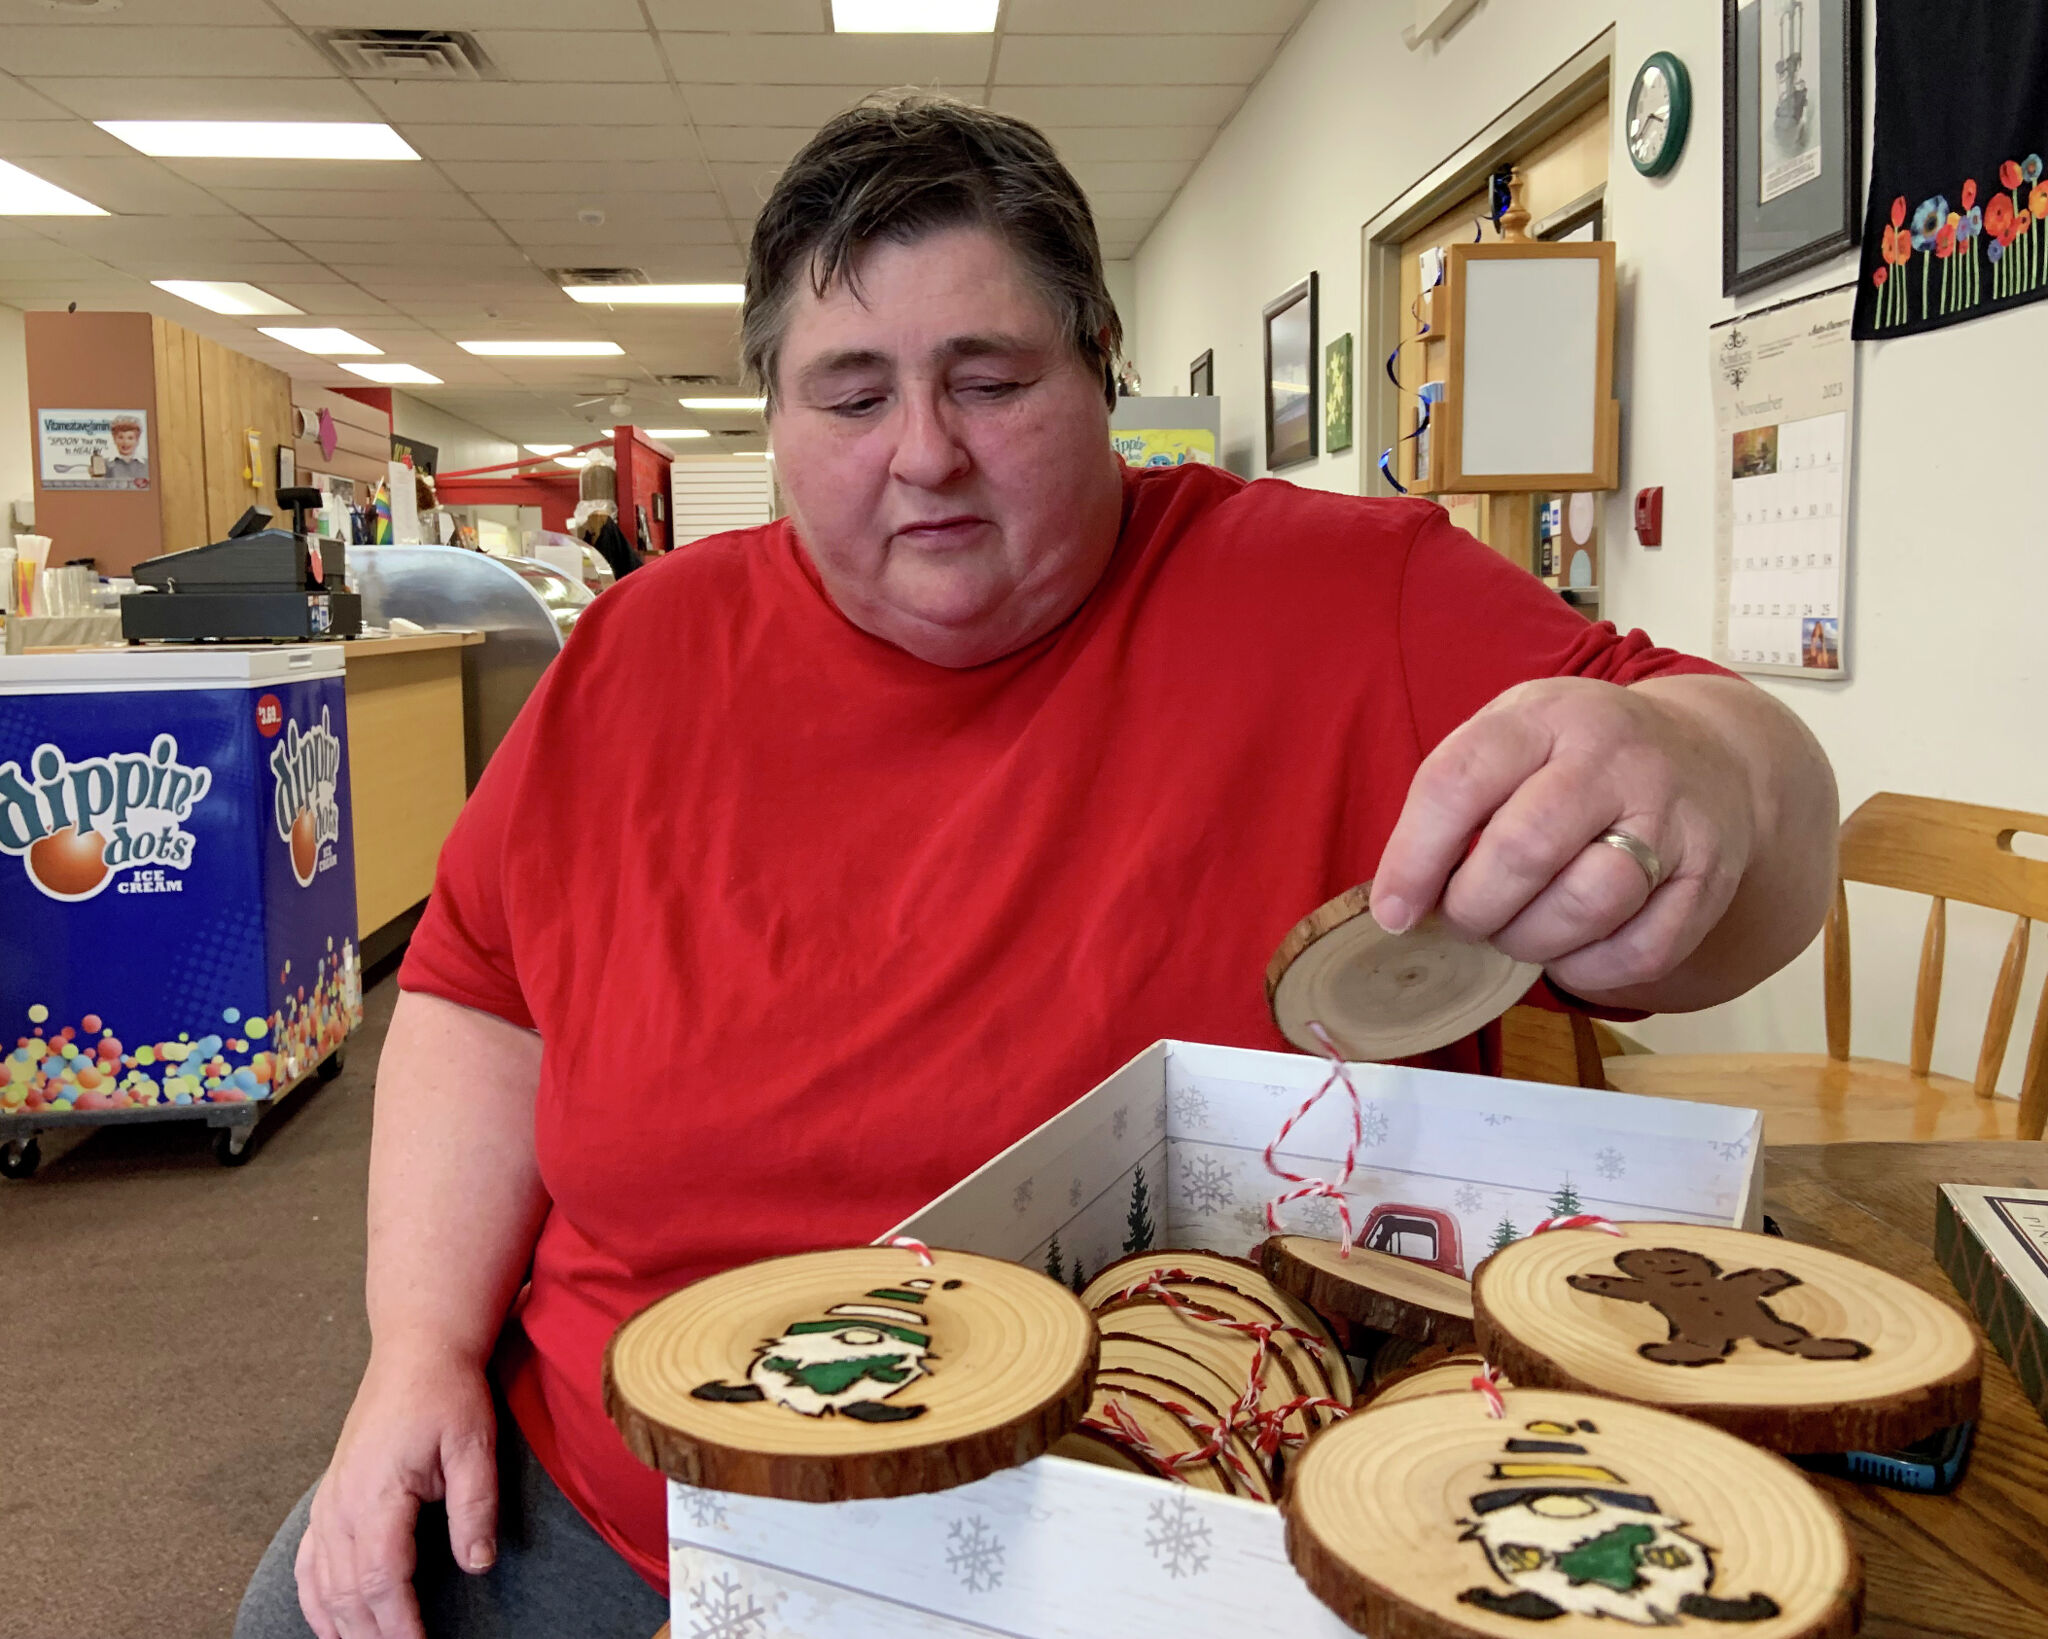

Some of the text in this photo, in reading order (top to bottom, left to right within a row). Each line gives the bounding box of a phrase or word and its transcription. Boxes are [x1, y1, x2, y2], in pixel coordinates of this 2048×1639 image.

[1822, 382, 1843, 400] 2023
[1735, 394, 1783, 417] November
[104, 826, 189, 866] dots
[133, 869, 165, 882] ICE
[117, 880, 183, 894] CREAM
